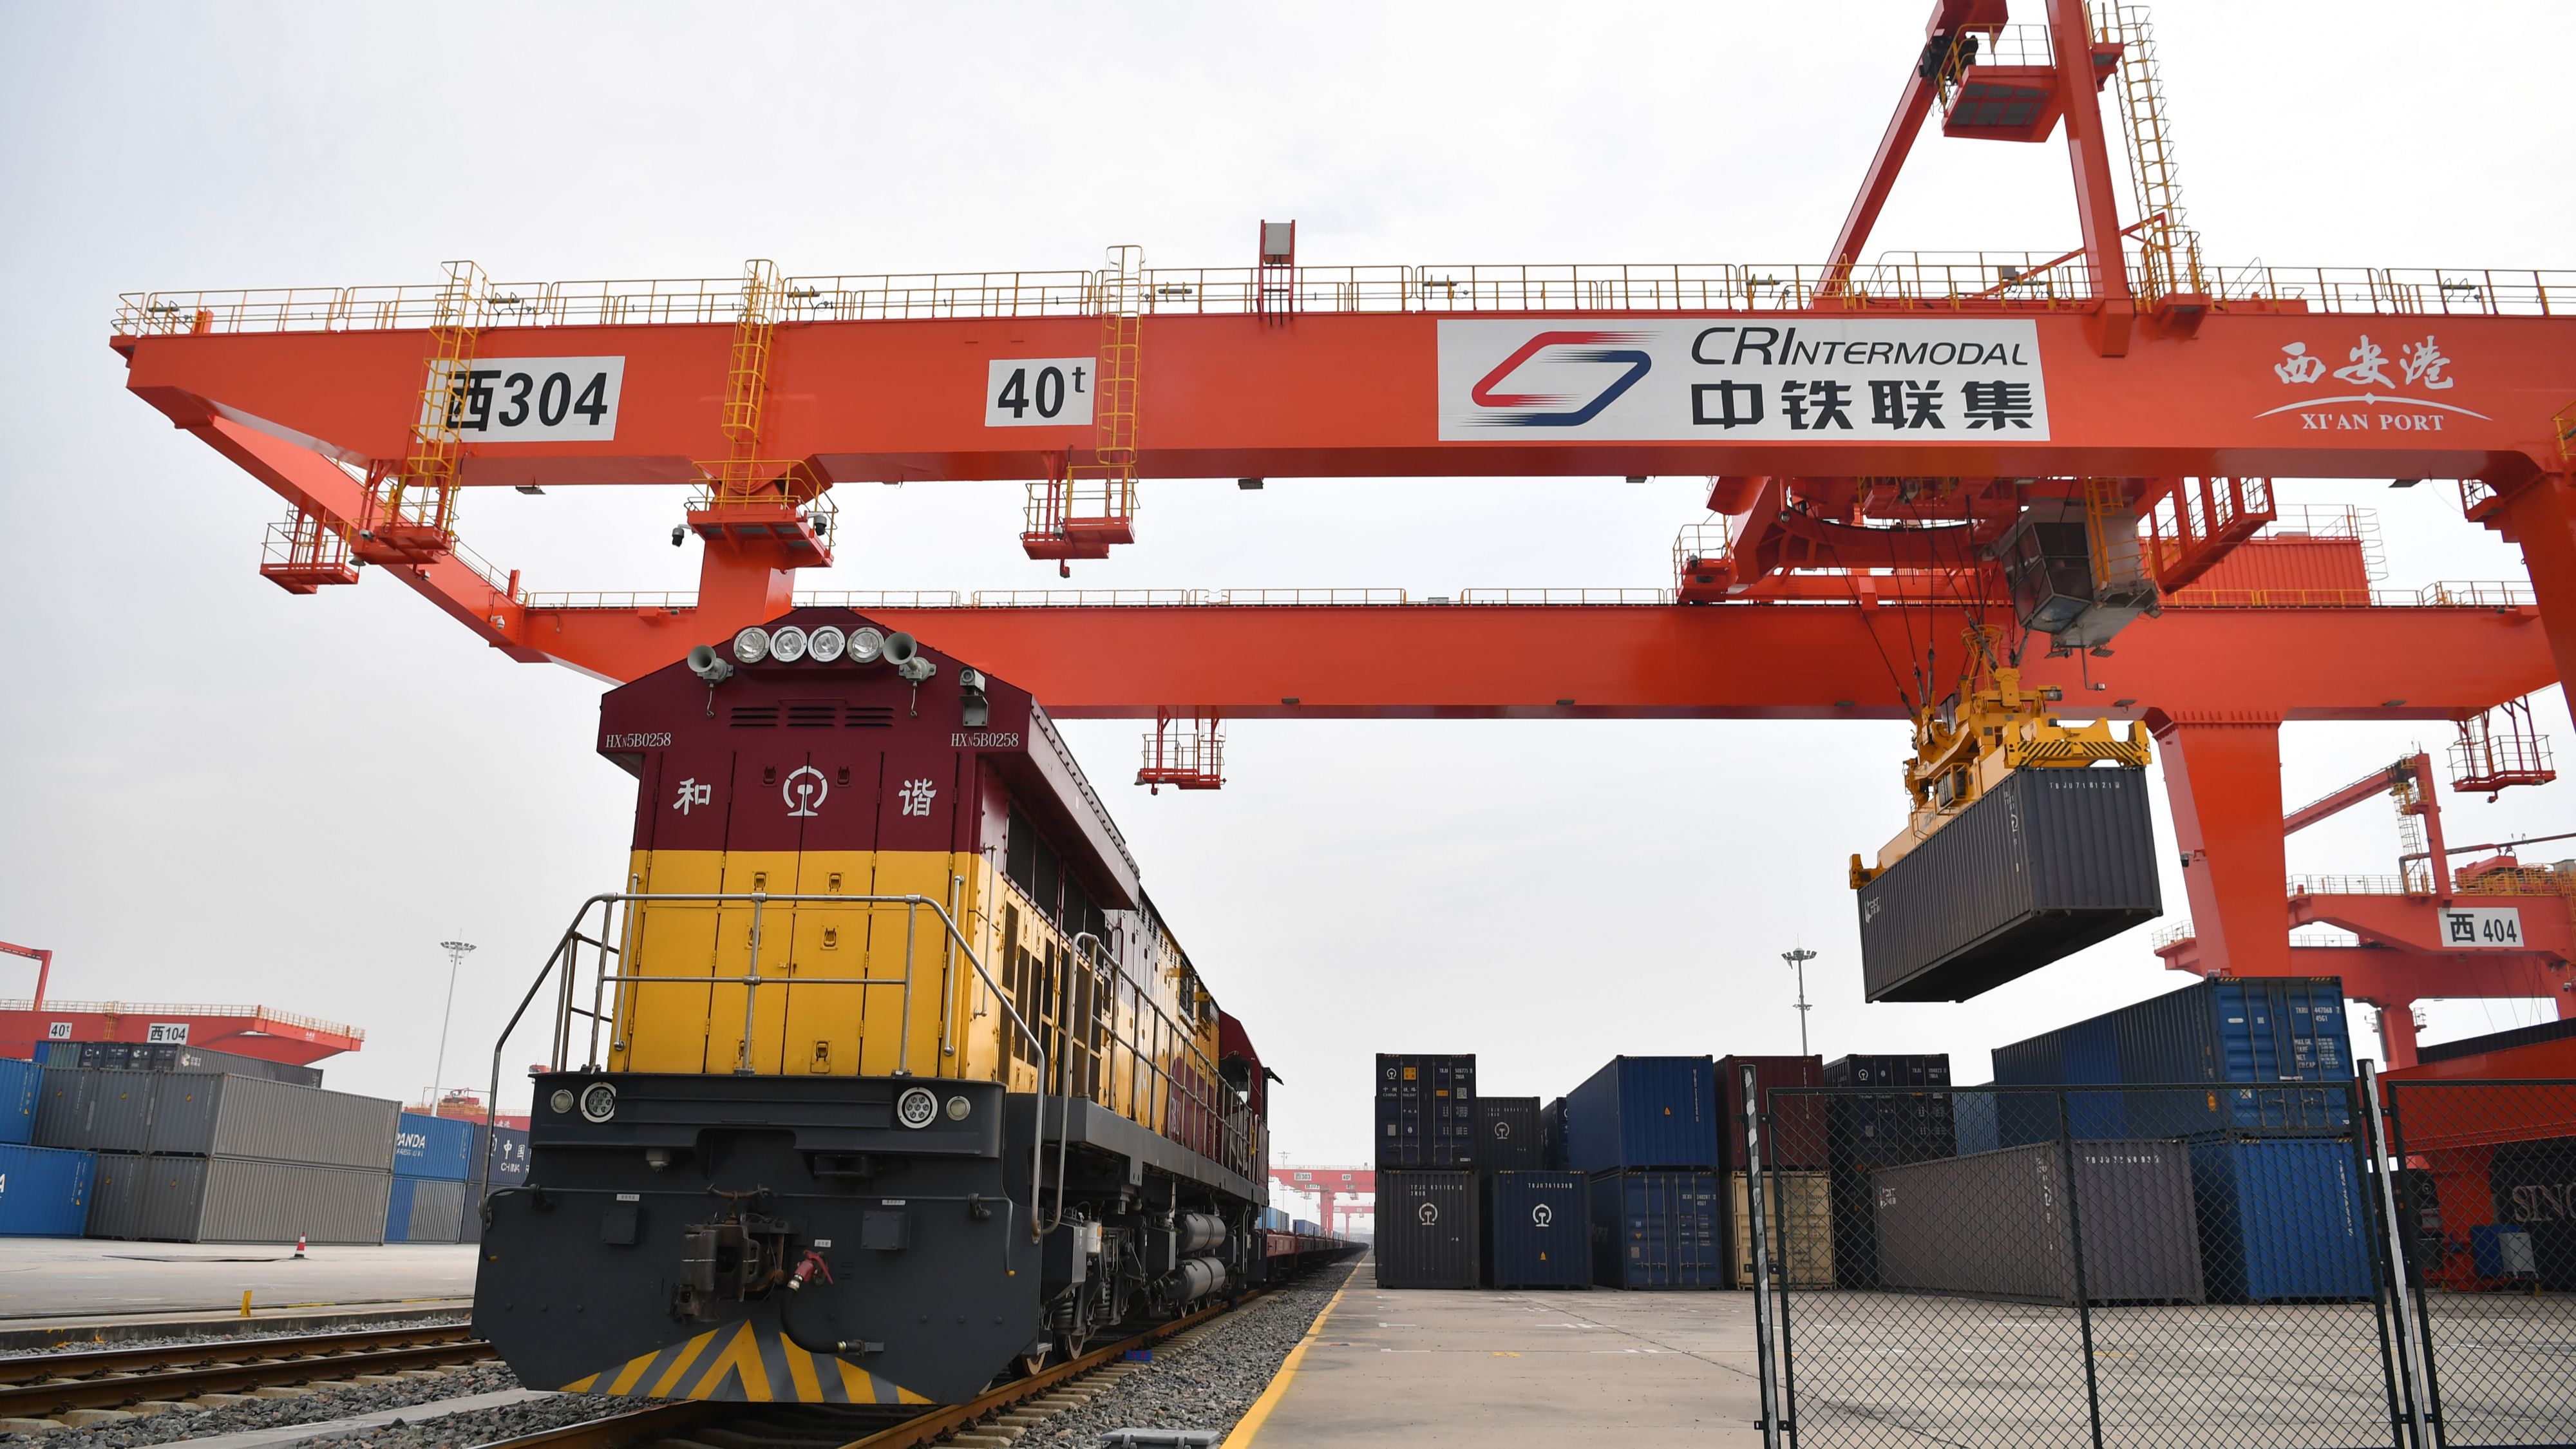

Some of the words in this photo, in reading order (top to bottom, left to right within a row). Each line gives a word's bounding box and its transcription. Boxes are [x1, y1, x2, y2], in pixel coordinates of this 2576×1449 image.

[2274, 335, 2454, 390] 西安港
[1692, 380, 2034, 430] 中铁联集
[2300, 413, 2369, 430] XI'AN
[2378, 414, 2444, 431] PORT
[672, 778, 711, 815] 和
[898, 778, 937, 817] 谐
[150, 1025, 186, 1041] 西104
